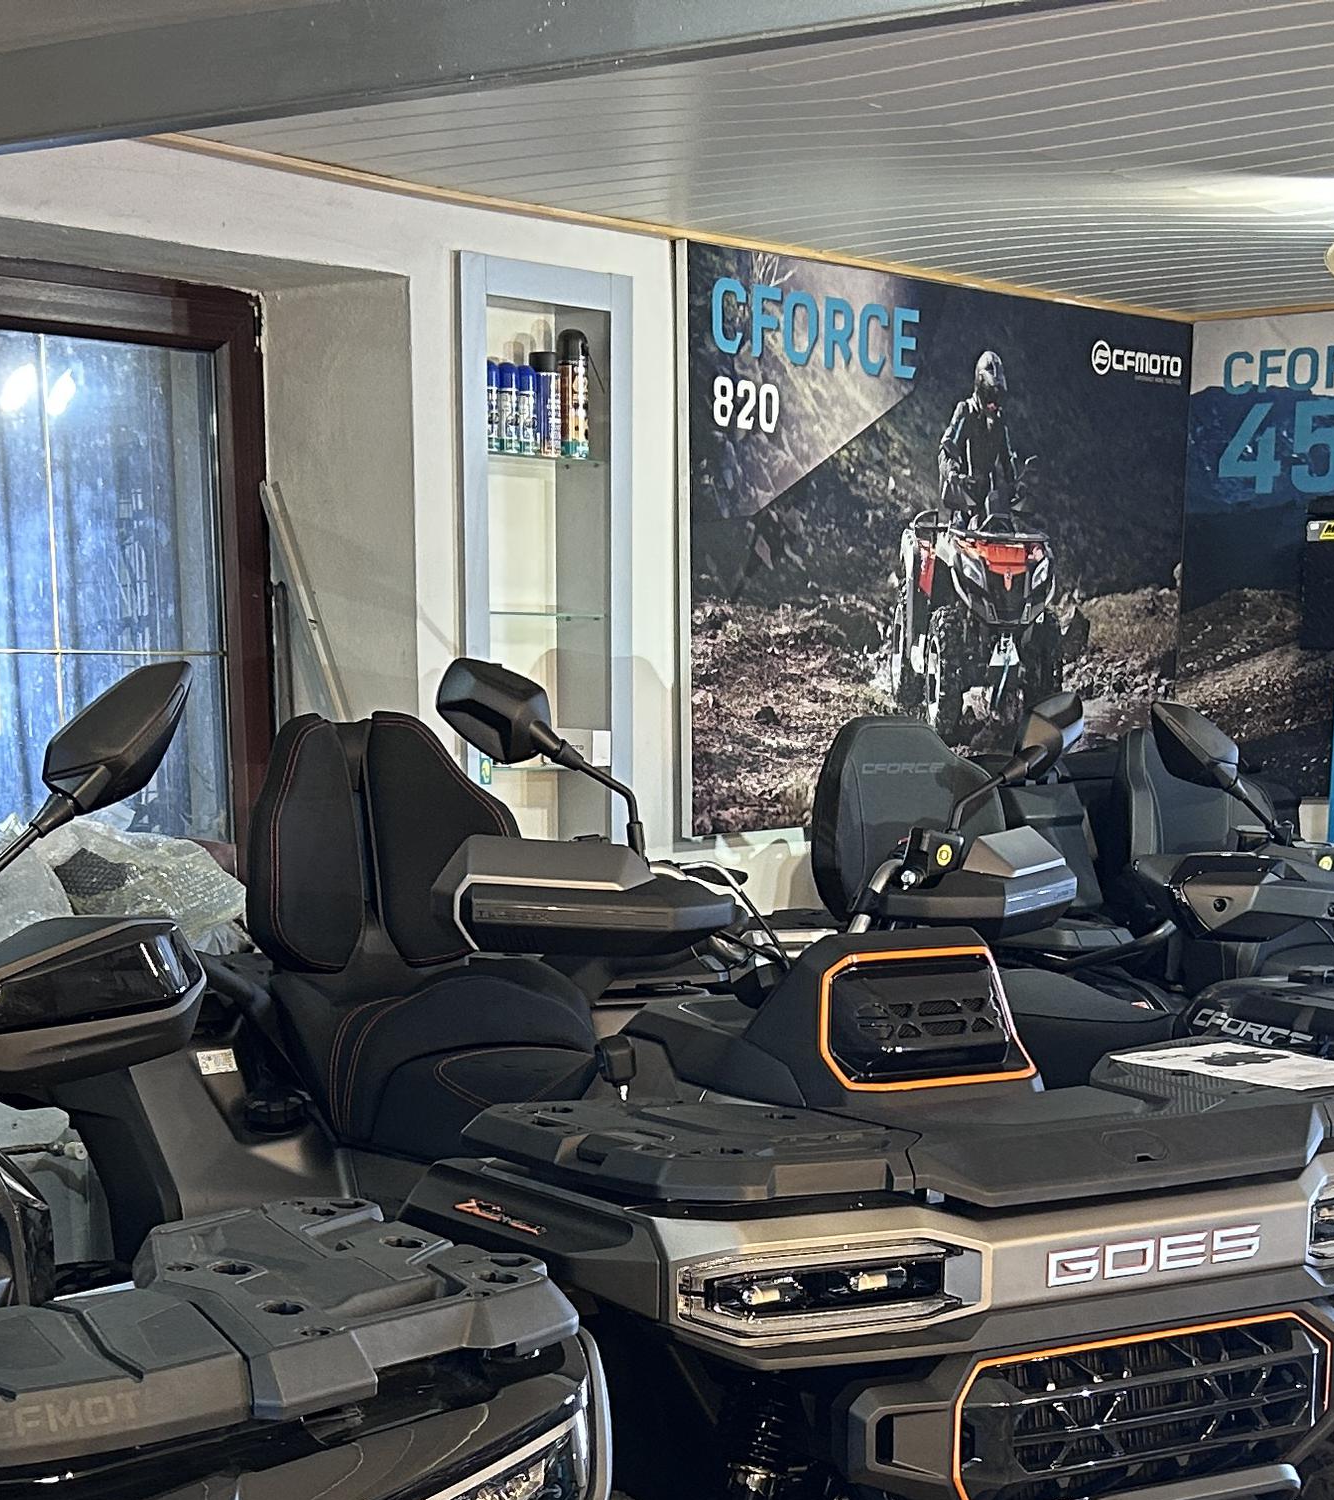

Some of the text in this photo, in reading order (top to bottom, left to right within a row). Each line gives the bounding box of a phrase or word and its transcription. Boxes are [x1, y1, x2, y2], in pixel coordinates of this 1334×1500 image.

[711, 277, 921, 380] CFORCE
[1112, 348, 1182, 378] CFMOTO
[711, 375, 780, 434] 820
[862, 761, 946, 776] CFORCE
[1046, 1223, 1262, 1288] GOES
